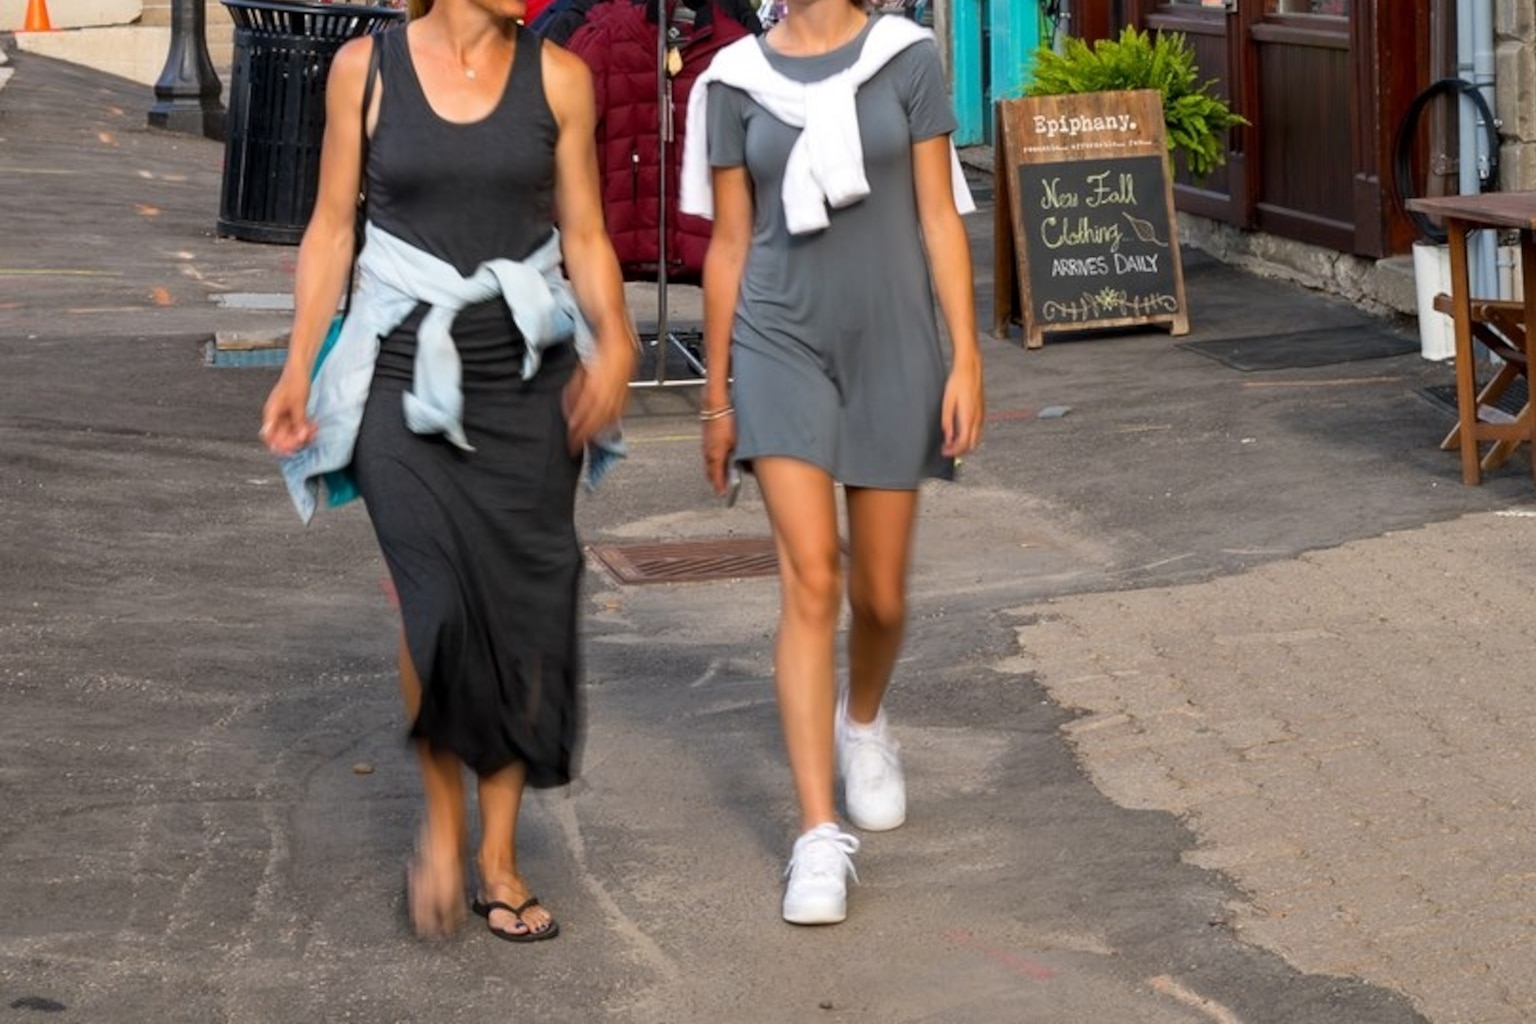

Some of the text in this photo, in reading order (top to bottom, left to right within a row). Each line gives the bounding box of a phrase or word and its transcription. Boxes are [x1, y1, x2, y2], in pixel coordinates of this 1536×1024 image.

[1033, 114, 1137, 137] Epiphany.
[1041, 170, 1138, 210] New Fall
[1052, 252, 1159, 277] ARRIVES DAILY
